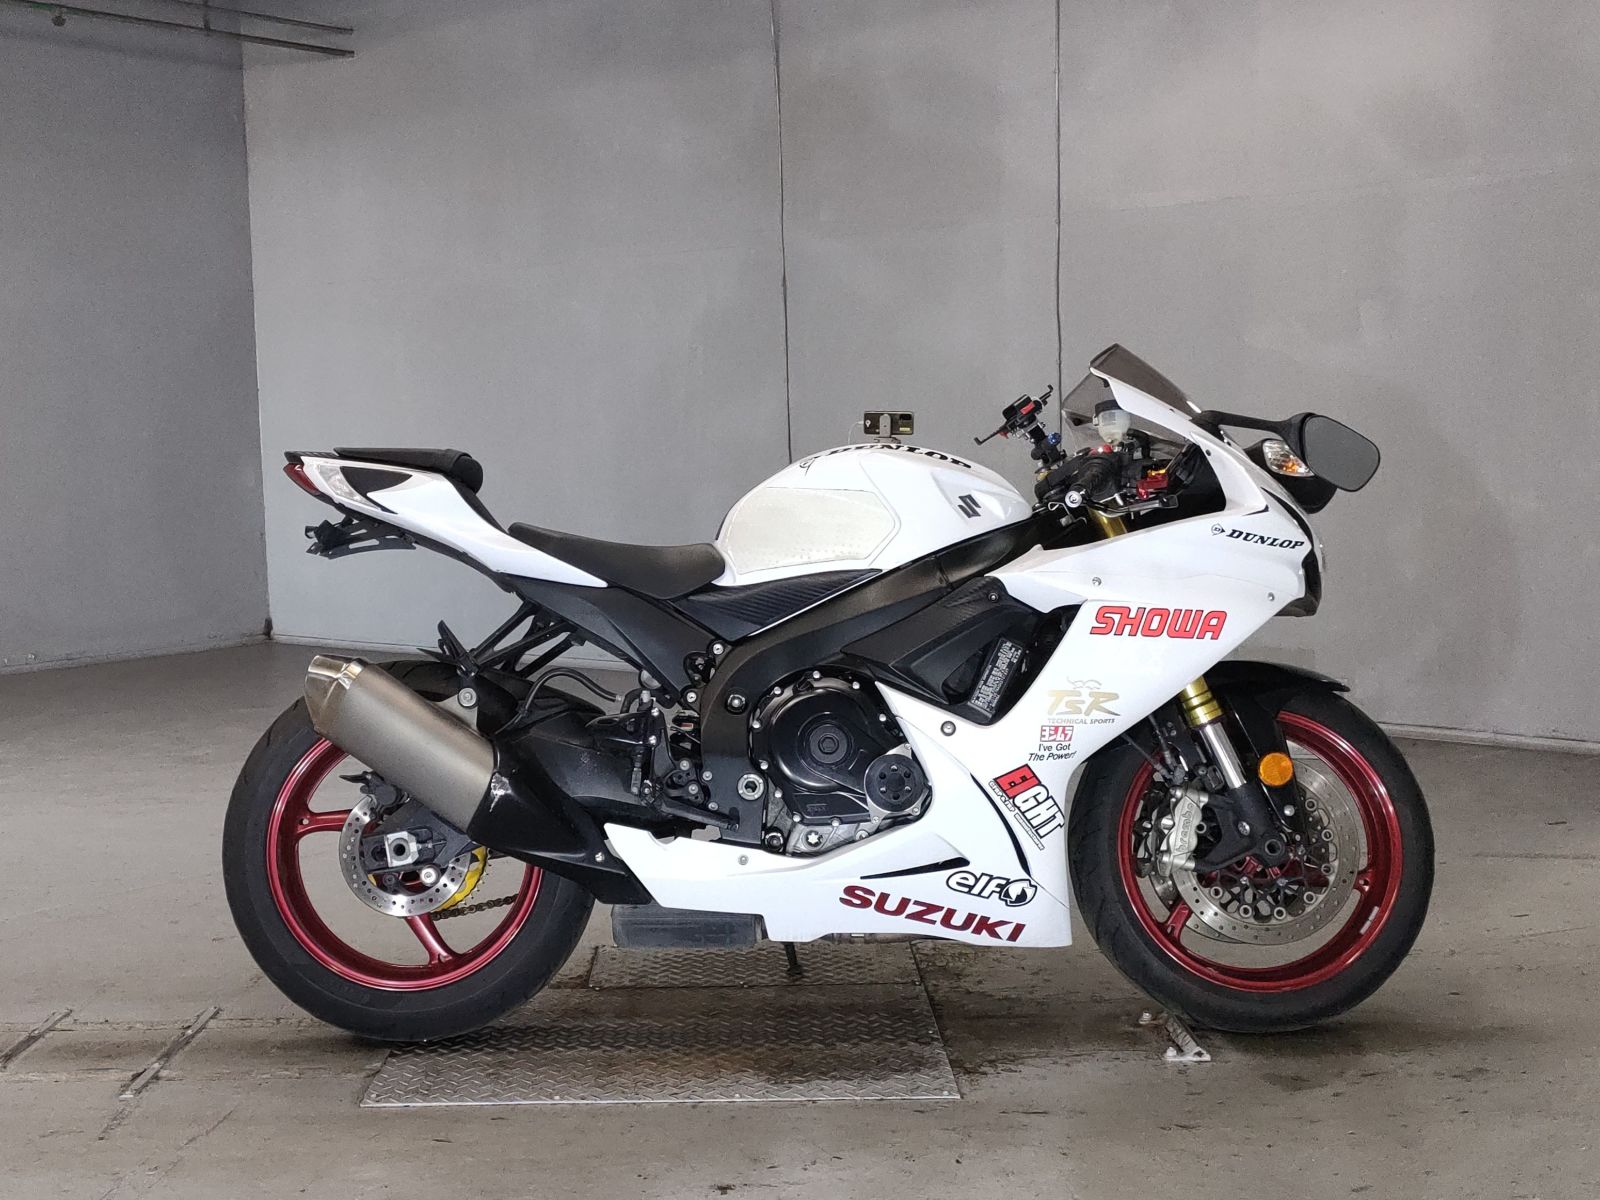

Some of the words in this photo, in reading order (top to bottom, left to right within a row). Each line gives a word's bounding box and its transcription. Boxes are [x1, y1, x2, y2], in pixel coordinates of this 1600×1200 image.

[1226, 529, 1305, 549] DUNLOP
[1090, 605, 1228, 640] SHOWA
[1028, 753, 1045, 761] The
[1038, 744, 1053, 752] I've
[1055, 743, 1071, 752] Got
[993, 763, 1066, 839] EIGHT
[1175, 803, 1194, 852] brembo
[946, 871, 1009, 900] elf
[839, 885, 1026, 942] SUZUKI
